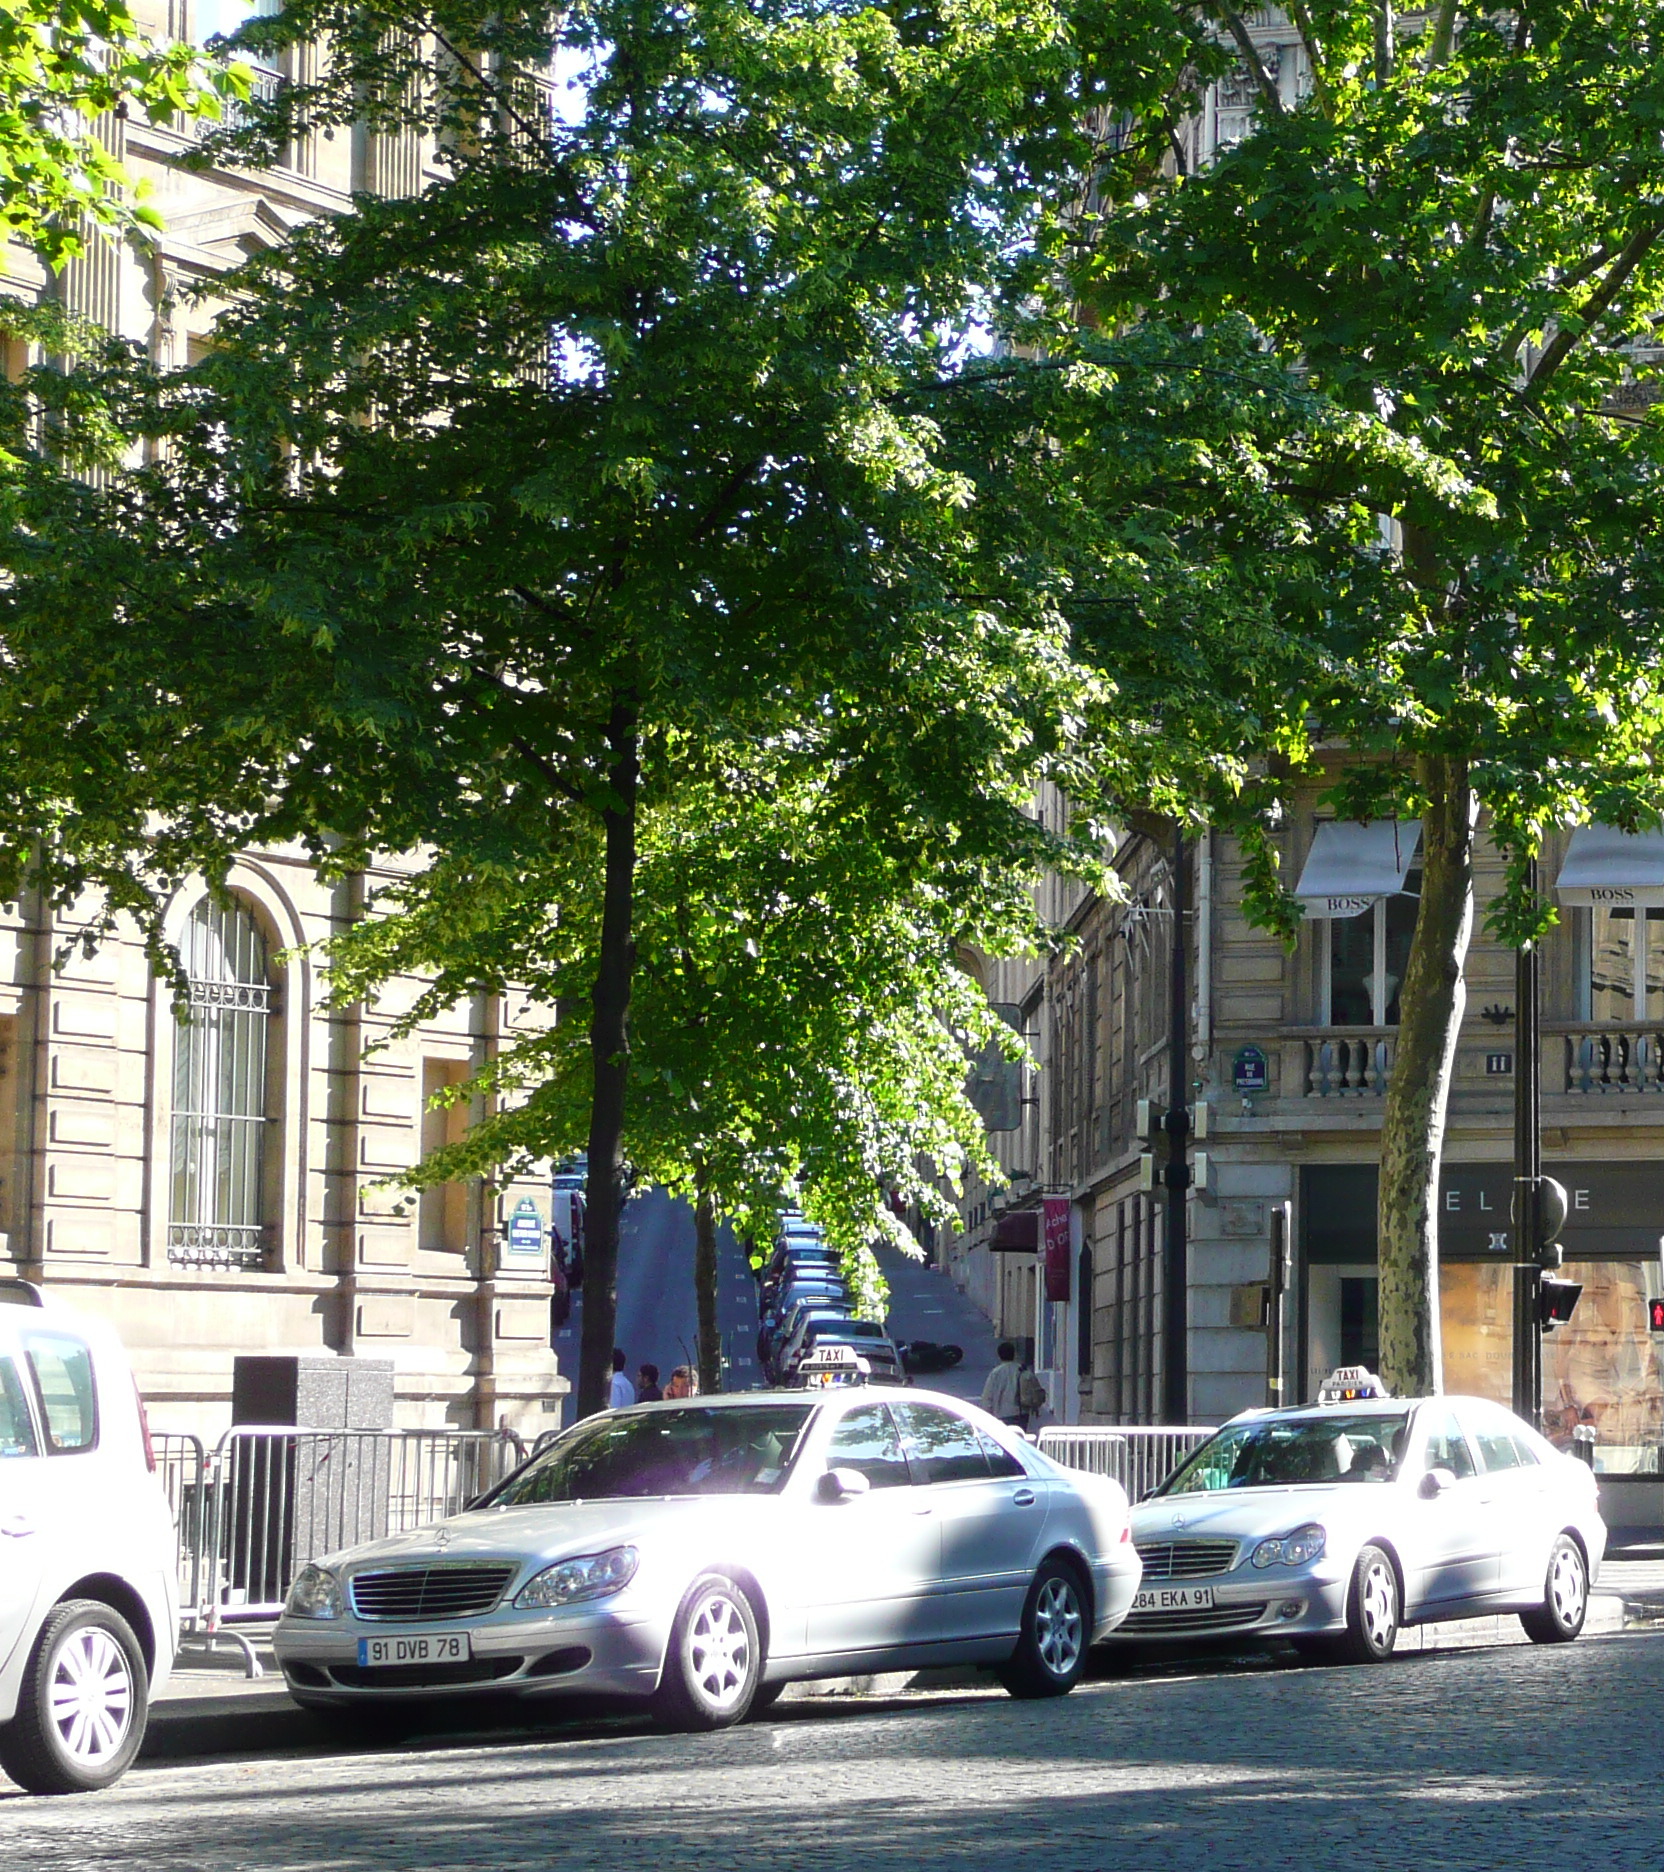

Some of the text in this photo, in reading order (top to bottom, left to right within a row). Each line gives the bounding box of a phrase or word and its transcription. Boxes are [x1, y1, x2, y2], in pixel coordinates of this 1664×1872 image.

[1591, 889, 1634, 900] BOSS
[1328, 898, 1369, 911] BOSS
[1491, 1056, 1506, 1072] 11
[819, 1348, 845, 1362] TAXI
[1336, 1369, 1359, 1381] TAXI
[1131, 1589, 1209, 1609] 284 EKA 91
[372, 1638, 460, 1661] 91 DVB 78
